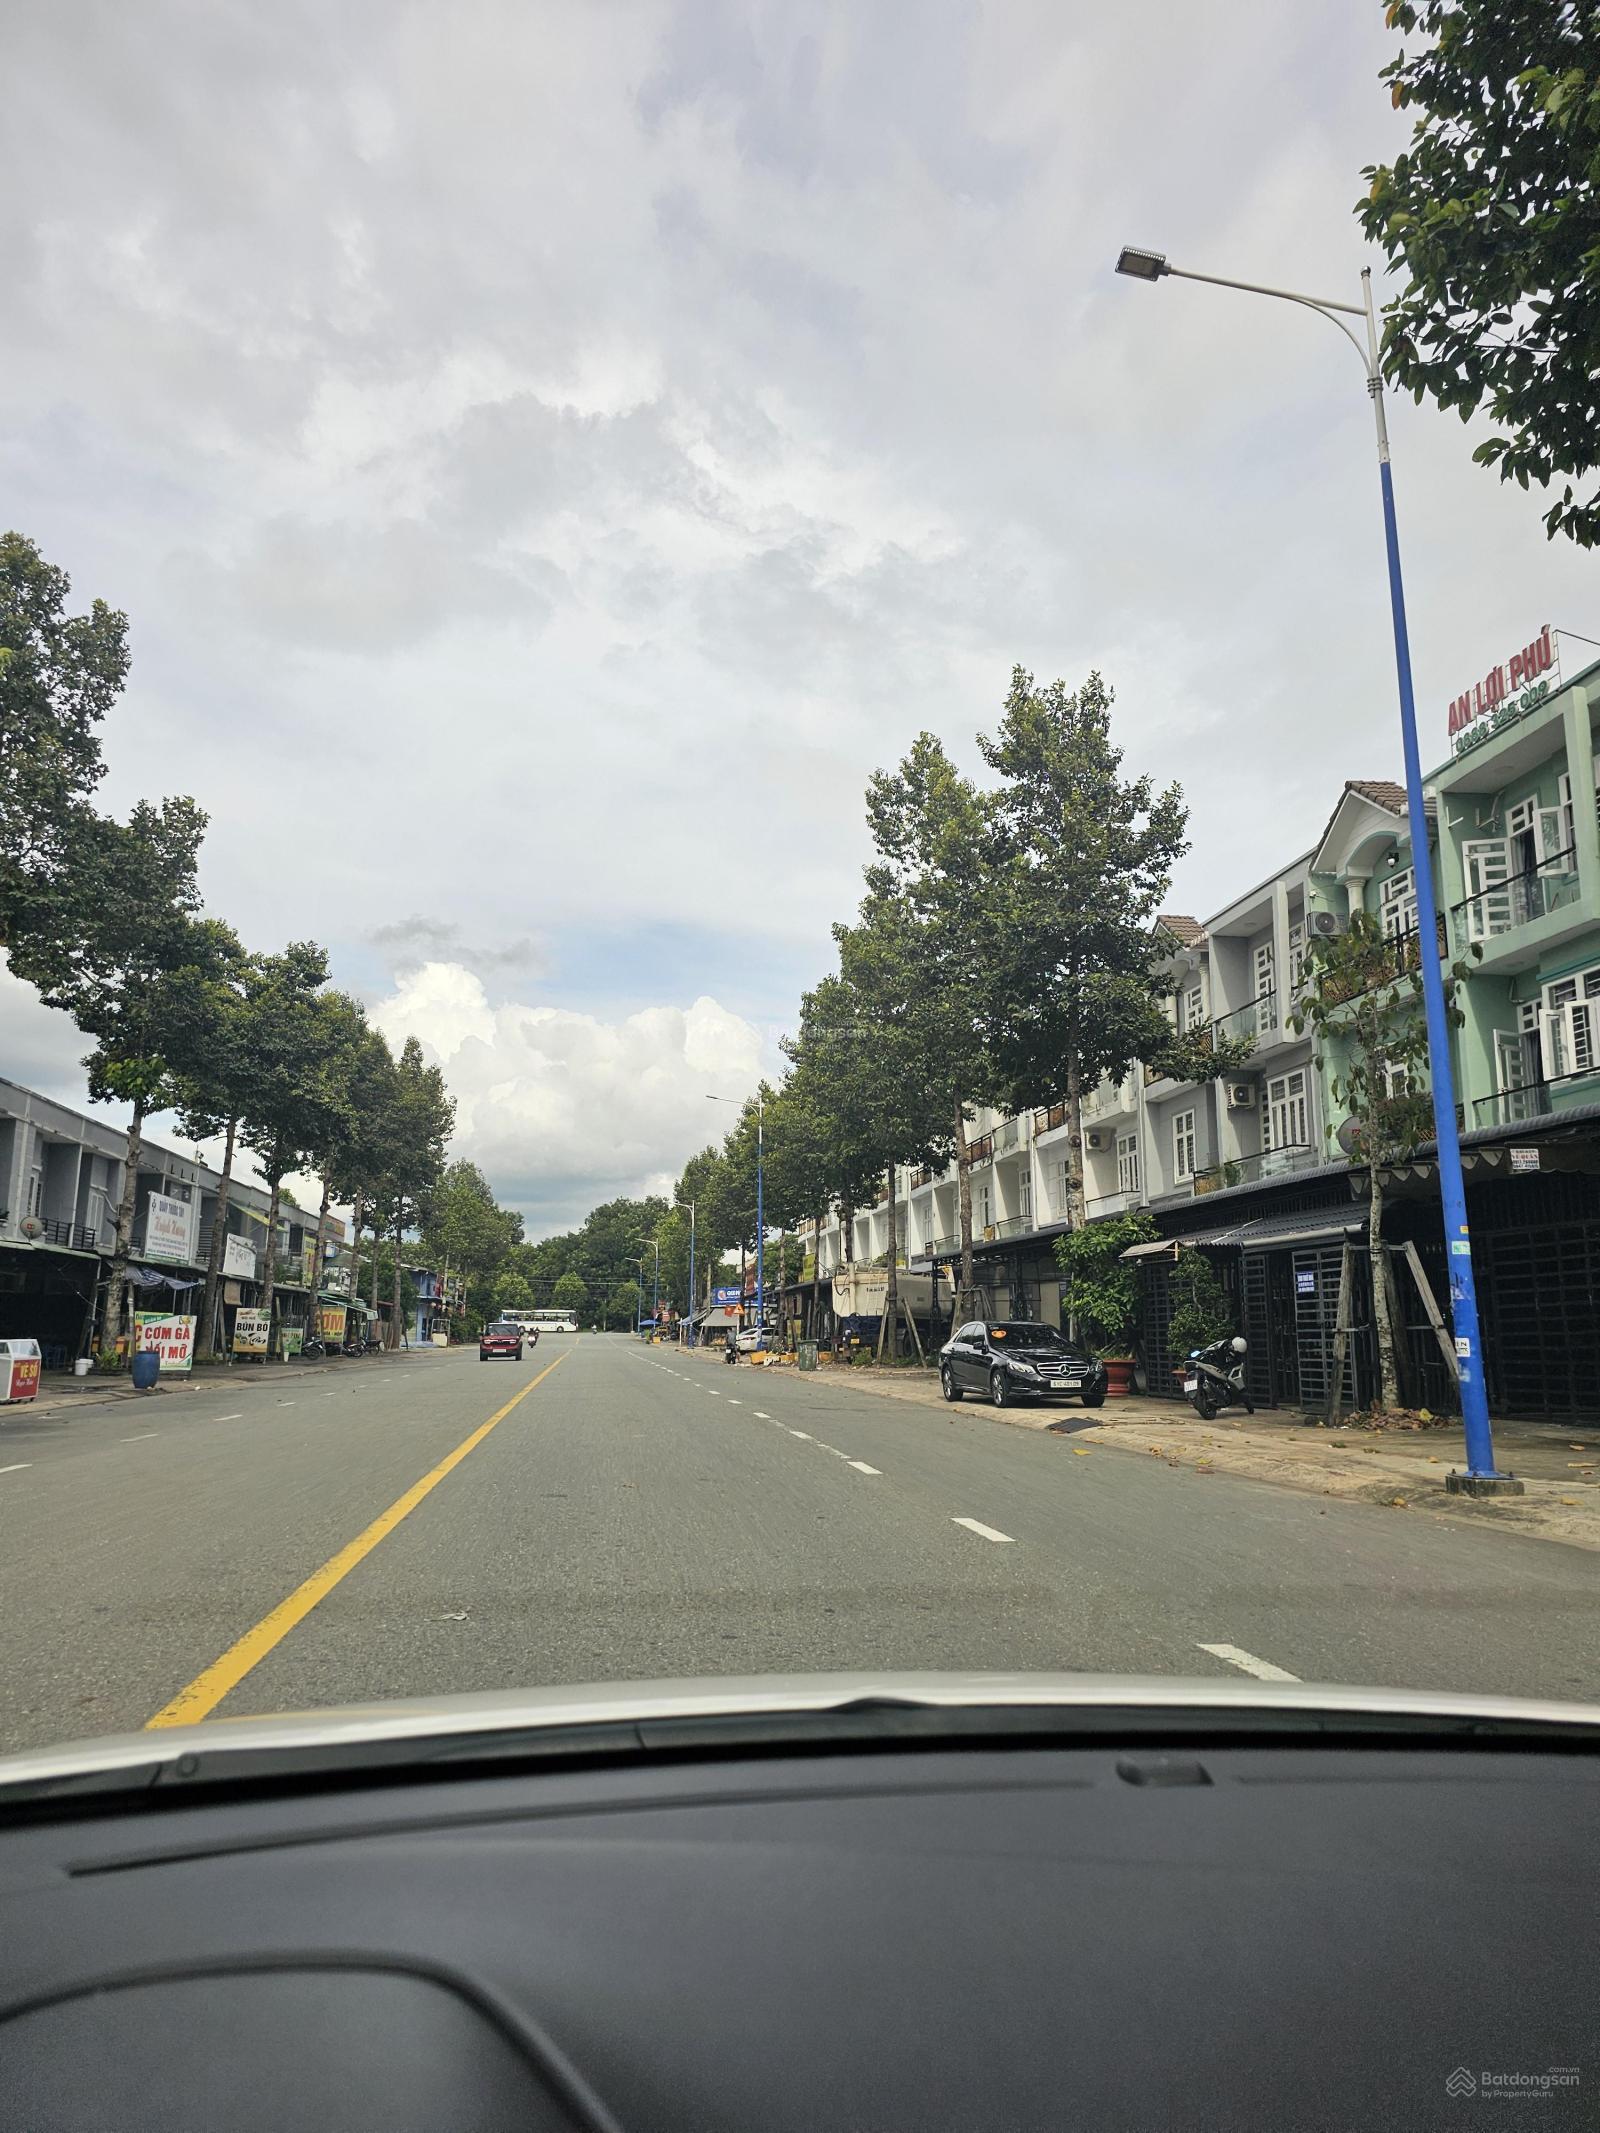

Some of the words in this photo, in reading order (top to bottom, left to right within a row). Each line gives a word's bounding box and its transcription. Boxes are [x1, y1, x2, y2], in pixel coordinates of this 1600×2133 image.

[1448, 691, 1475, 736] AN
[1509, 625, 1554, 691] PHÚ
[144, 1325, 172, 1340] CƠM
[174, 1324, 190, 1340] GÀ
[167, 1343, 188, 1359] MỠ
